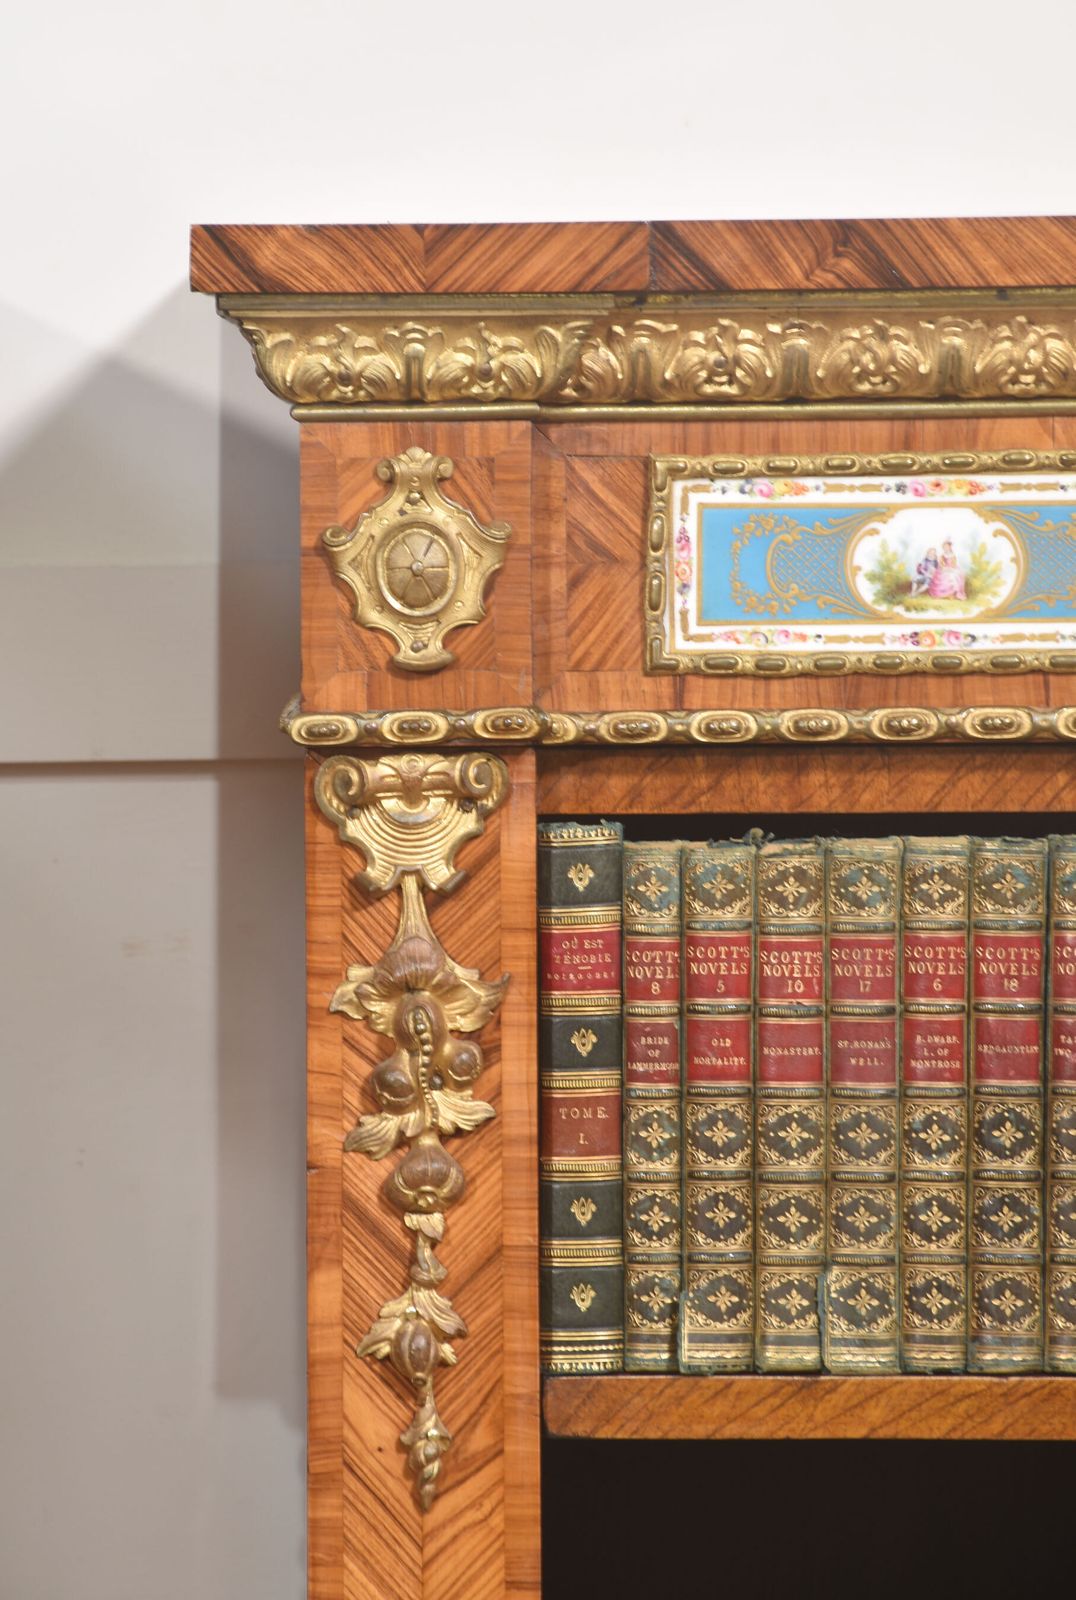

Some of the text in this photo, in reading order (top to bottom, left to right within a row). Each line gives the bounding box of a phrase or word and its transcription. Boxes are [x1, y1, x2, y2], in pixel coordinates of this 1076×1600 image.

[1055, 946, 1076, 958] SC
[690, 962, 748, 976] NOVELS
[763, 965, 821, 978] NOVELS
[834, 964, 893, 978] NOVELS
[908, 961, 965, 976] NOVELS
[979, 962, 1038, 976] NOVELS
[1057, 962, 1076, 976] NO
[651, 981, 661, 995] 8
[716, 979, 726, 993] 5
[787, 979, 805, 993] 10
[859, 979, 872, 993] 17
[932, 978, 943, 992] 6
[1003, 978, 1019, 992] 18
[640, 1036, 670, 1046] BRIDE
[711, 1038, 732, 1047] OLD
[1060, 1034, 1076, 1045] TA
[647, 1049, 661, 1058] OF
[936, 1047, 950, 1057] OF
[910, 1059, 961, 1069] MONTROSE
